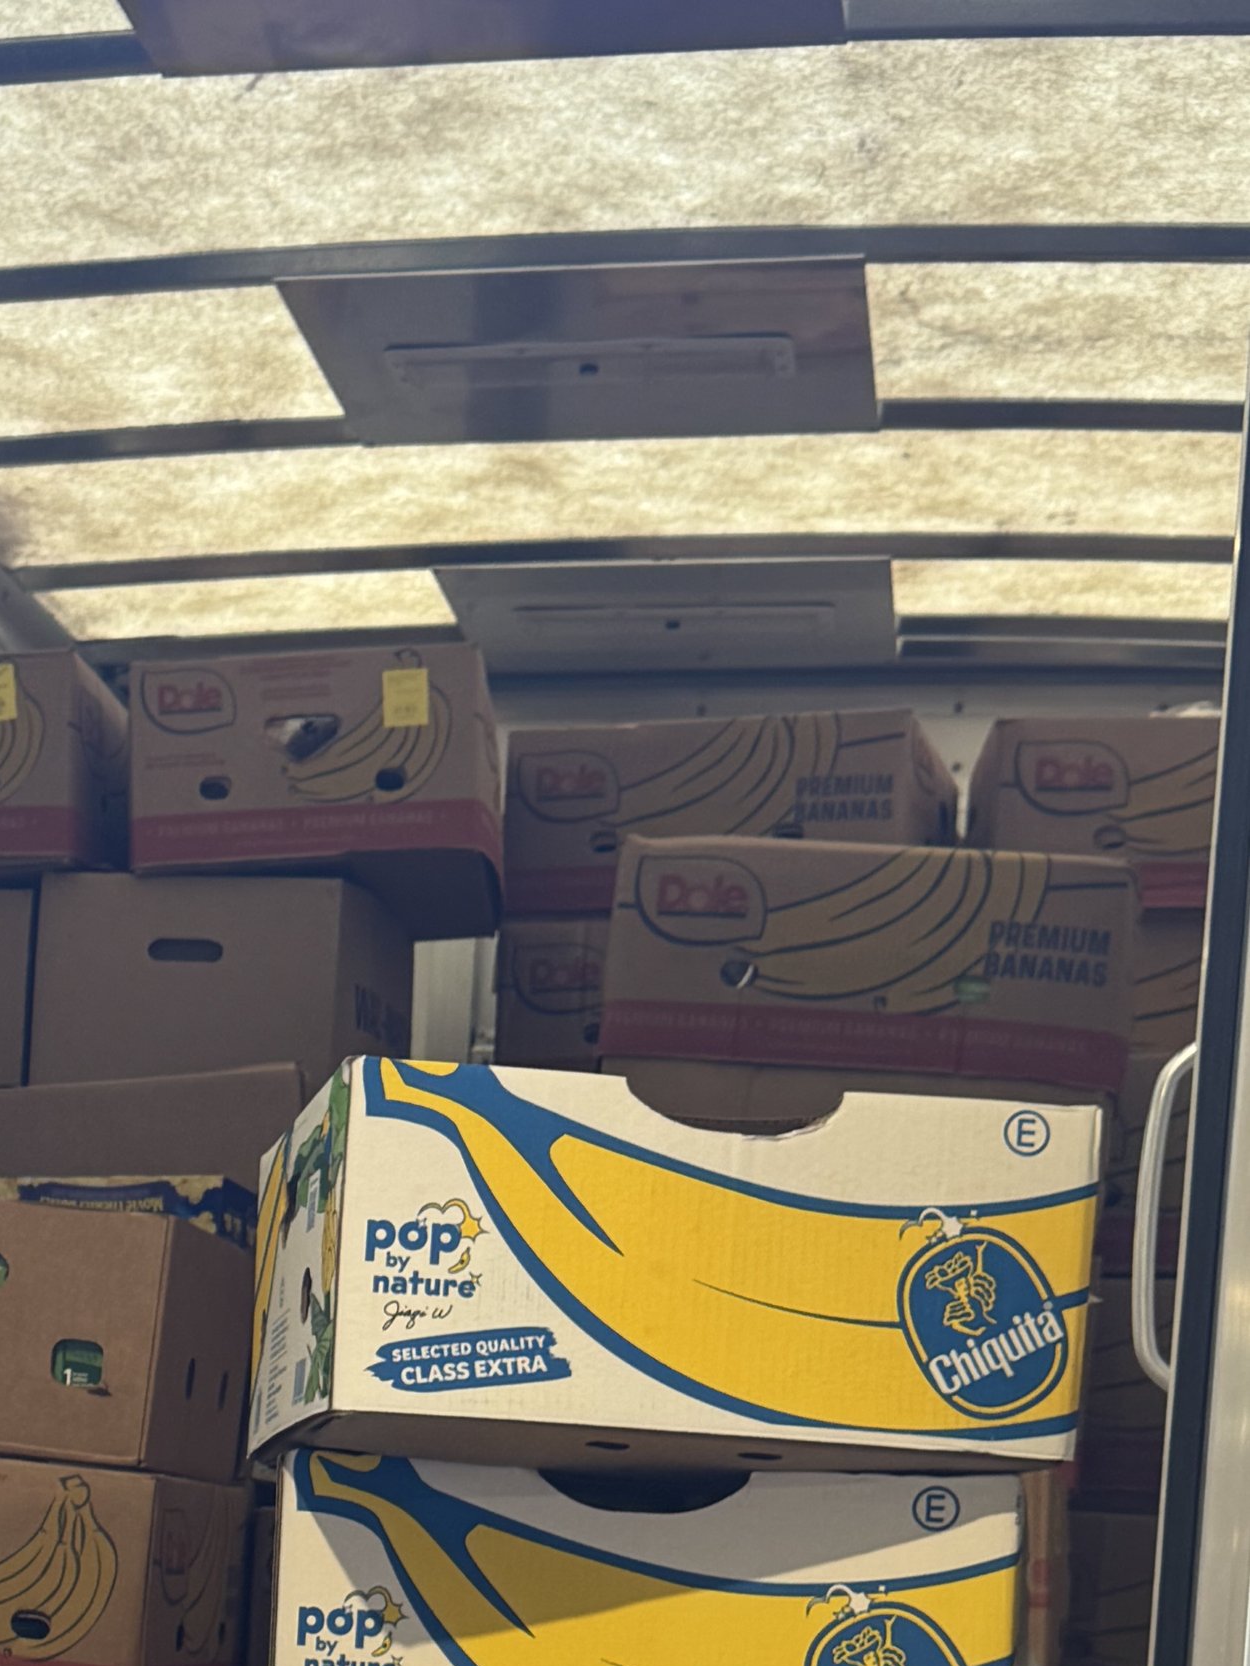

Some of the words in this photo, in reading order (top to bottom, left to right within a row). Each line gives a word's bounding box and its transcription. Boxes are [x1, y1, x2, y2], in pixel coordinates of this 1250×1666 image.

[158, 682, 223, 711] Dole
[796, 773, 893, 798] PREMIUM
[1035, 756, 1114, 786] Dole
[793, 797, 892, 823] BANANAS
[658, 873, 747, 913] Dole
[988, 920, 1111, 957] PREMIUM
[983, 951, 1109, 988] BANANAS
[365, 1219, 462, 1266] pop
[386, 1251, 410, 1272] by
[372, 1271, 476, 1299] nature
[392, 1342, 471, 1363] SELECTED
[476, 1335, 546, 1356] QUALITY
[927, 1309, 1064, 1395] Chiquita
[400, 1362, 470, 1386] CLASS
[474, 1355, 547, 1378] EXTRA
[296, 1606, 384, 1649] pop
[315, 1636, 338, 1656] by
